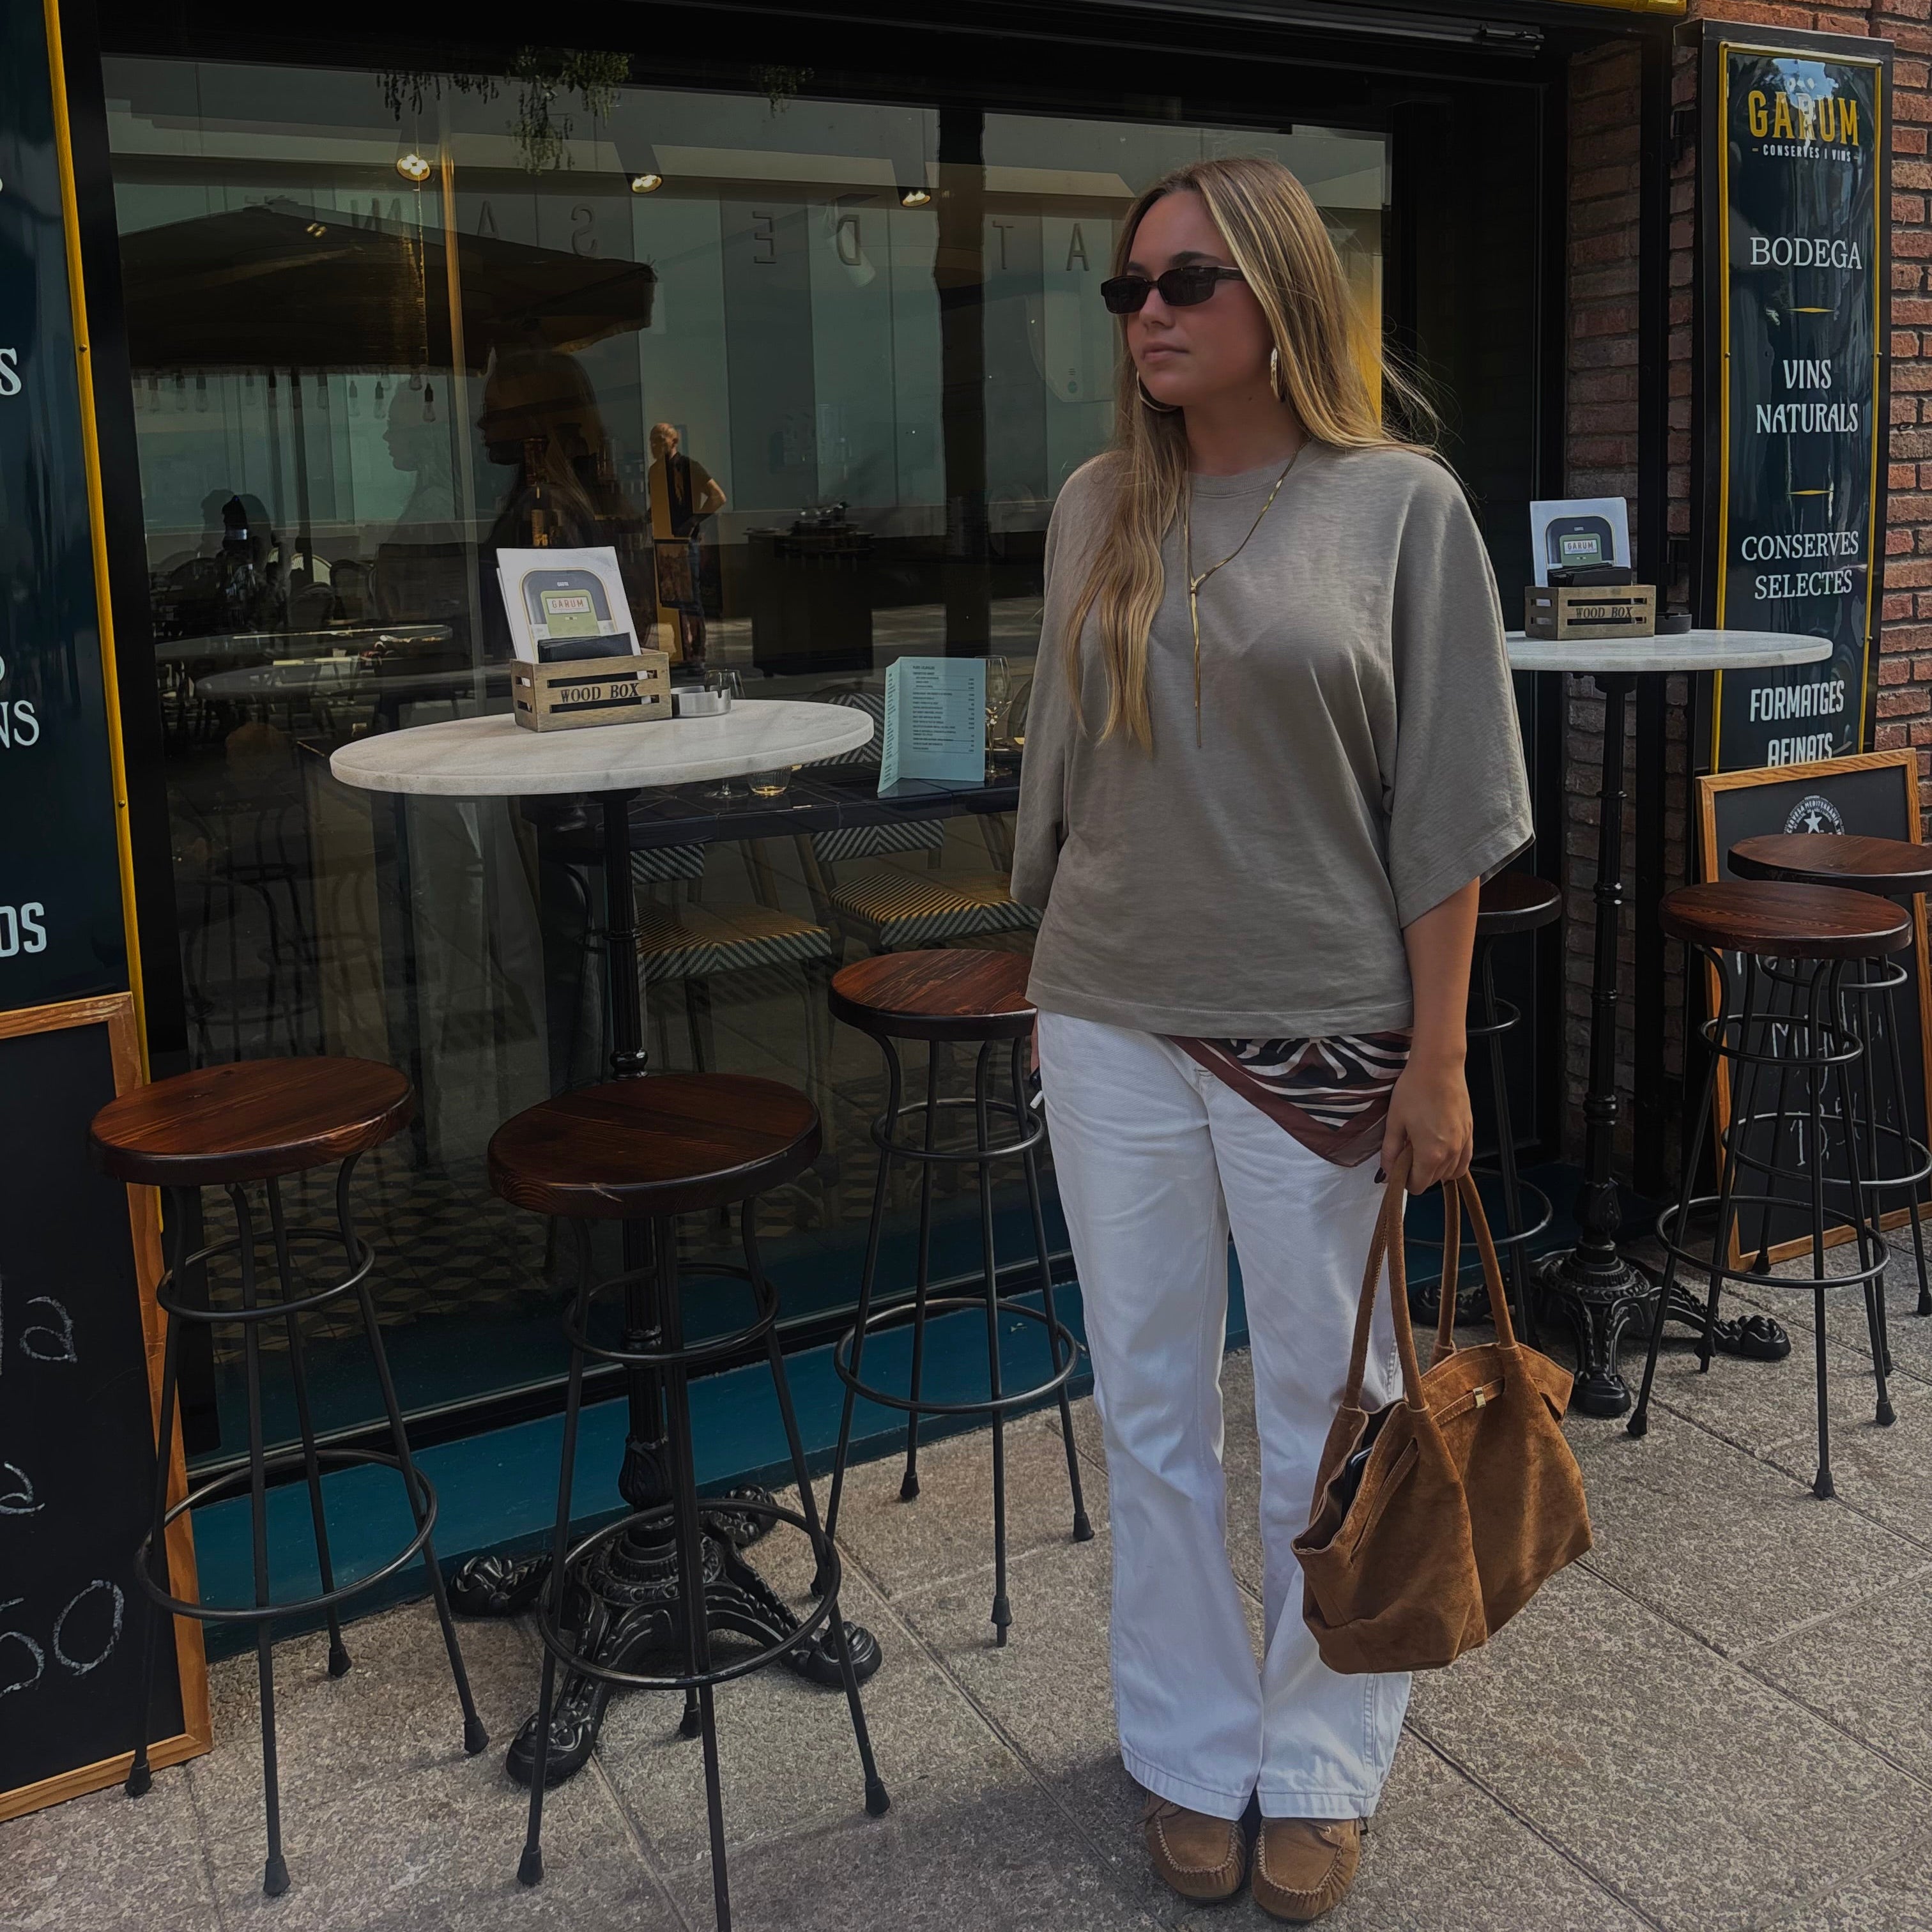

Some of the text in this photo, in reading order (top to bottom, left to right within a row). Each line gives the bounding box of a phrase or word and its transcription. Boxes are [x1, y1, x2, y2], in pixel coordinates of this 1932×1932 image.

[1748, 89, 1859, 146] GARUM
[1763, 144, 1851, 162] CONSERVES I VINS
[1749, 236, 1862, 270] BODEGA
[1782, 359, 1832, 390] VINS
[1756, 402, 1859, 434] NATURALS
[1567, 541, 1593, 550] GARUM
[1741, 530, 1859, 562] CONSERVES
[1754, 569, 1852, 600] SELECTES
[551, 599, 585, 609] GARUM
[1575, 606, 1634, 618] WOOD BOX
[560, 682, 640, 703] WOOD BOX
[1749, 679, 1845, 723] FORMATGES
[1767, 732, 1833, 767] AFINATS
